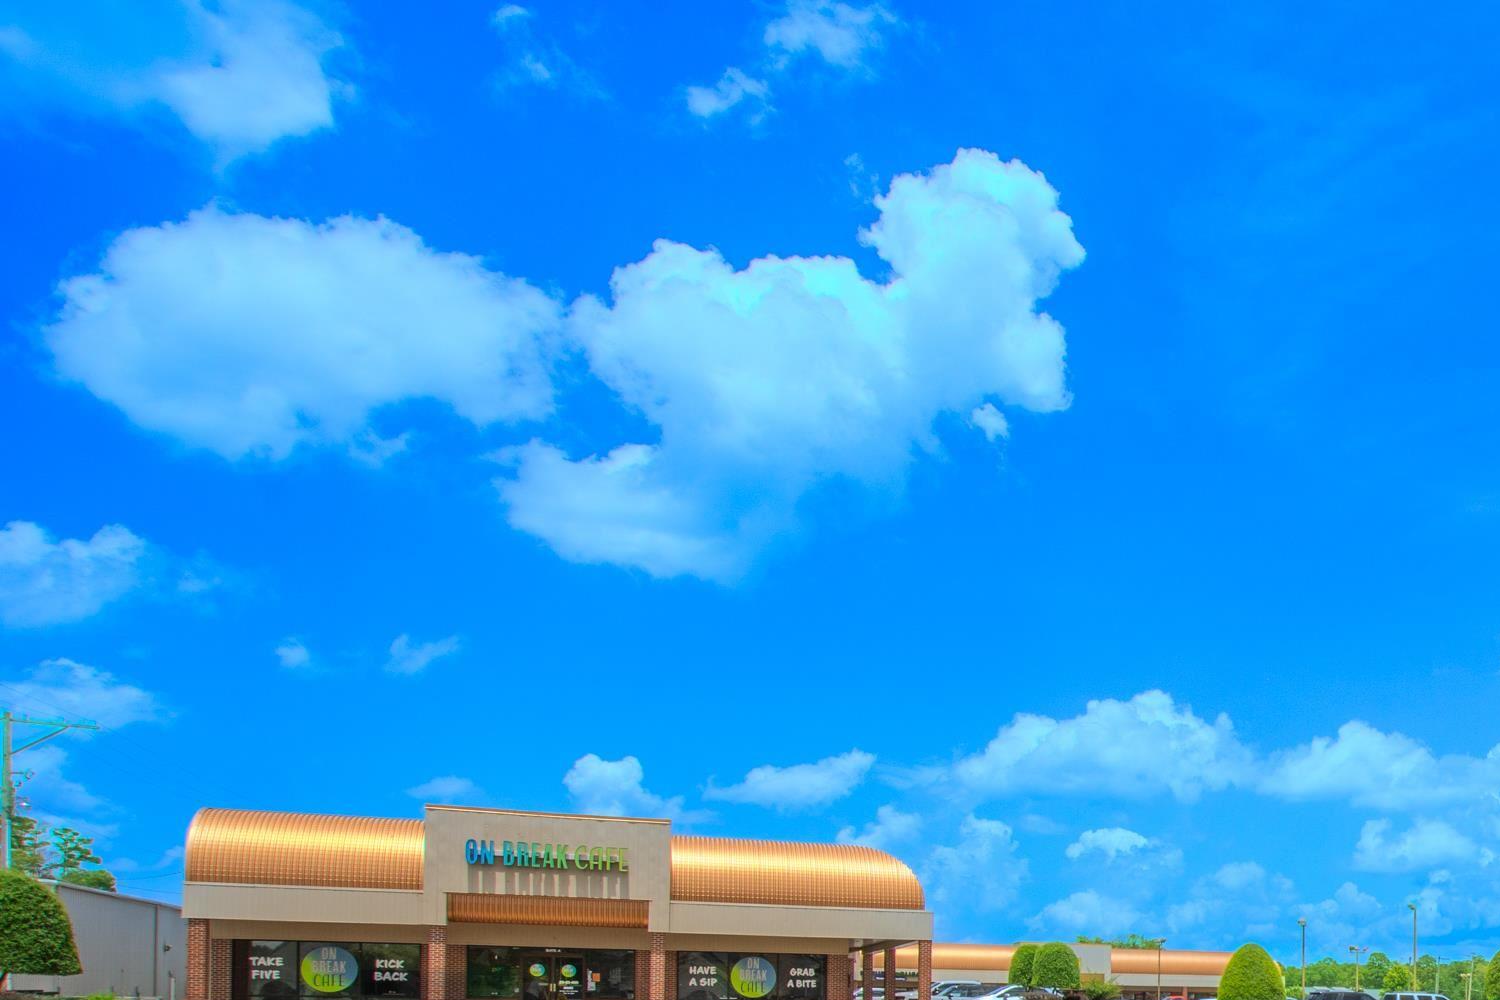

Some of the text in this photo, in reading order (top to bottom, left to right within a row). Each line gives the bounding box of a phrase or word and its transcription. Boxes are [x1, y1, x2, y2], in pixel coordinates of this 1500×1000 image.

[465, 838, 629, 873] ON BREAK CAFE
[321, 947, 337, 960] ON
[249, 956, 284, 967] TAKE
[311, 960, 347, 974] BREAK
[376, 959, 405, 969] KICK
[747, 957, 760, 970] ON
[251, 969, 280, 980] FIVE
[689, 966, 717, 975] HAVE
[739, 969, 767, 982] BREAK
[789, 967, 815, 977] GRAB
[313, 974, 345, 987] CAFE
[374, 972, 408, 982] BACK
[689, 977, 717, 987] A SIP
[787, 979, 817, 988] A BITE
